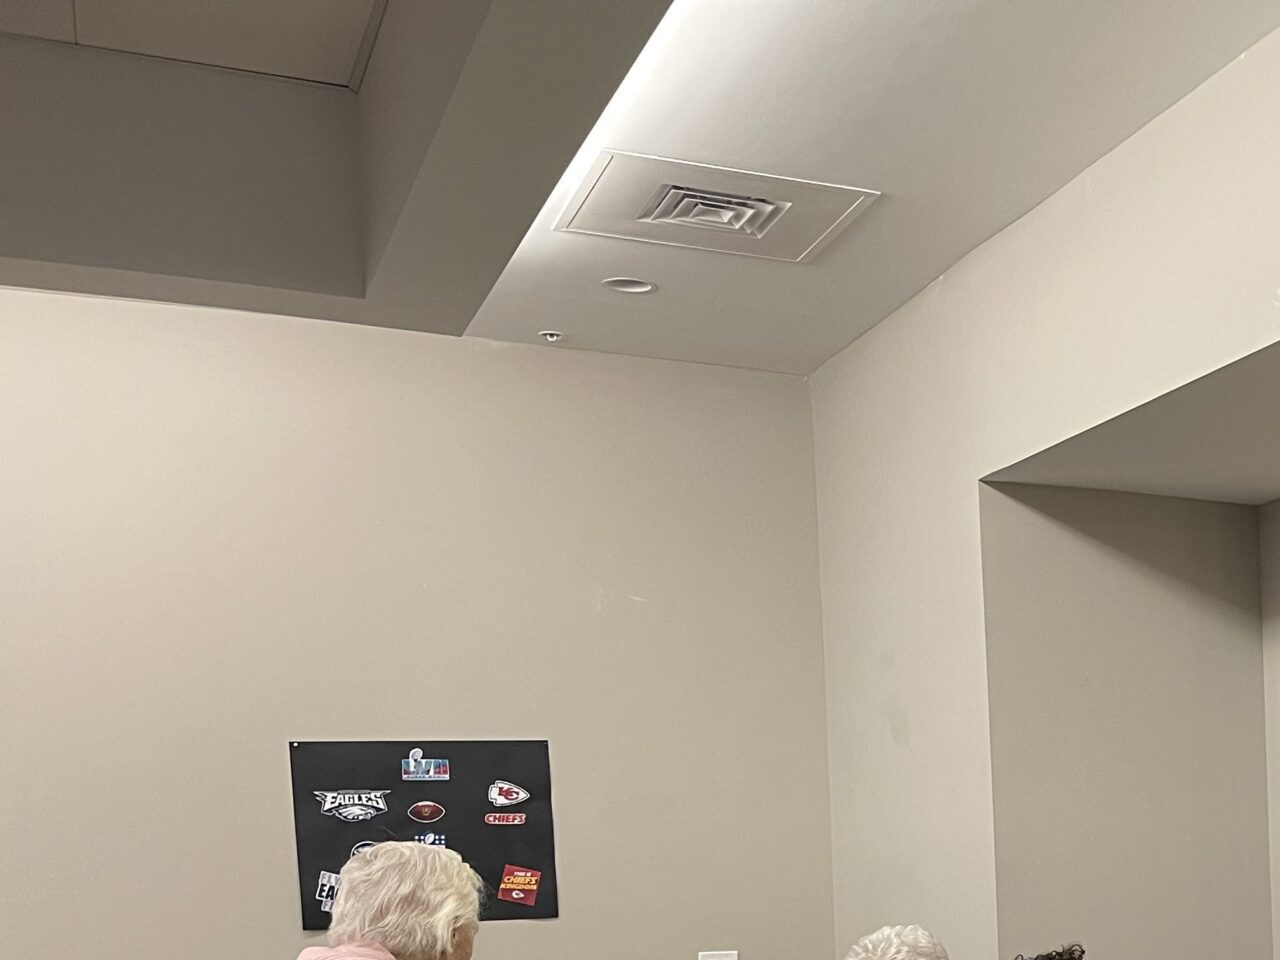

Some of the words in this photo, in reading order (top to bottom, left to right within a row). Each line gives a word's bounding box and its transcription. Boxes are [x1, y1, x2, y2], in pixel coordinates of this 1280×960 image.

[323, 791, 386, 811] EAGLES
[485, 814, 526, 824] CHIEFS
[503, 875, 538, 885] CHIEFS
